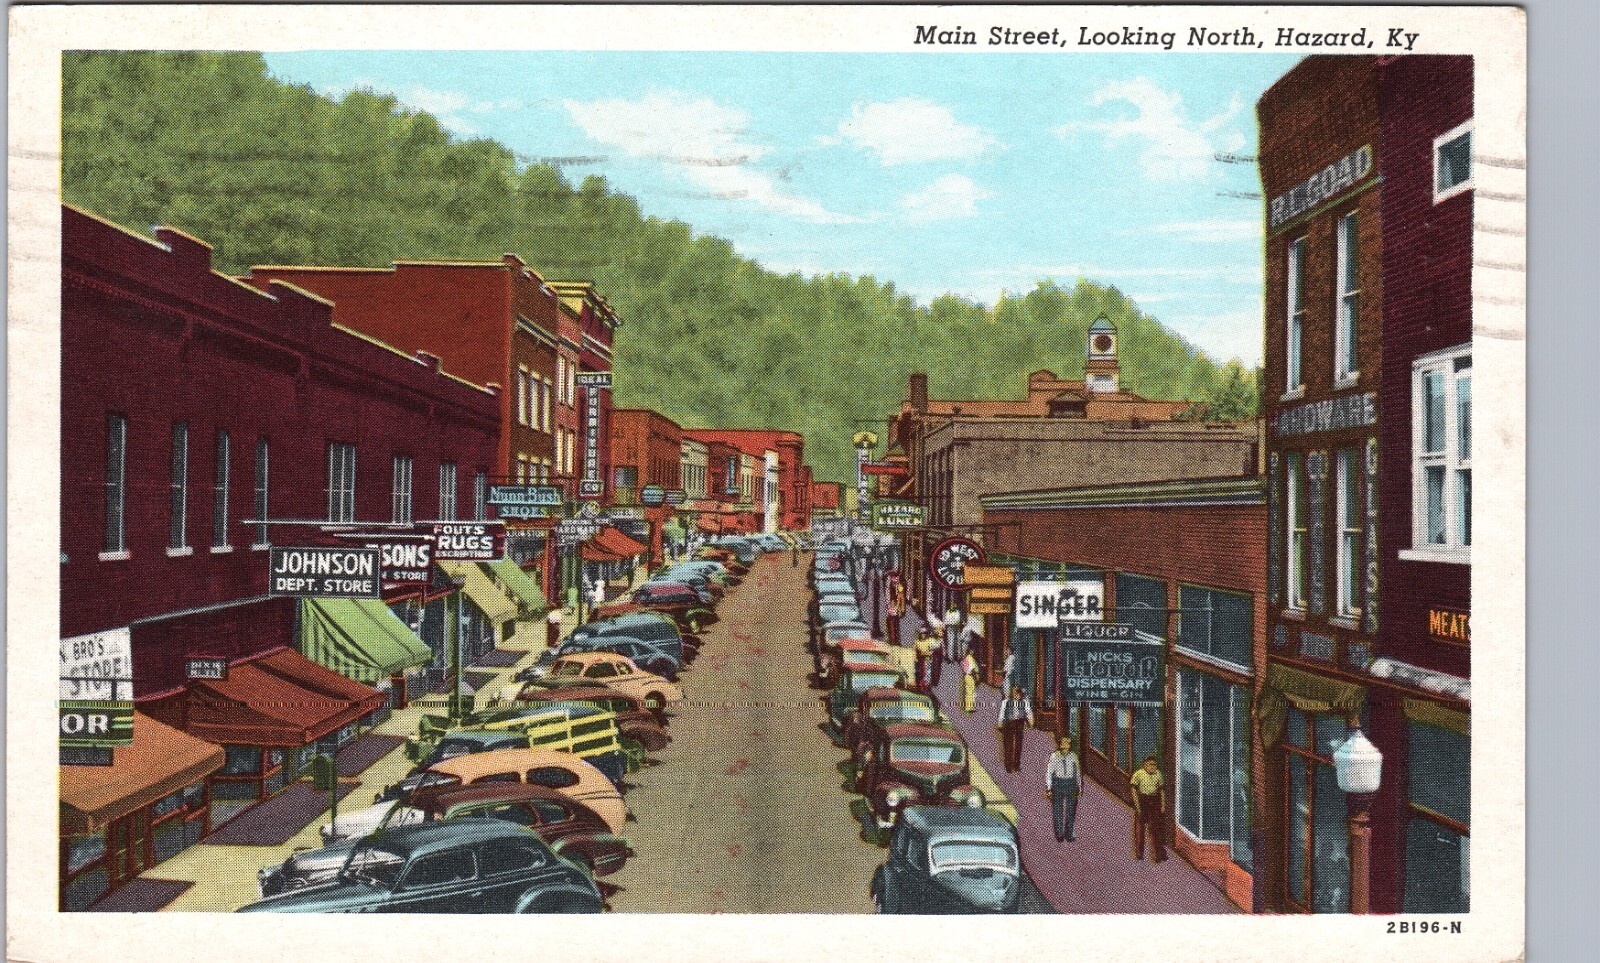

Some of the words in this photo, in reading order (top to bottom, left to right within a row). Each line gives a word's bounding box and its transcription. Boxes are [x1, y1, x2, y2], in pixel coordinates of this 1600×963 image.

[502, 506, 548, 517] SHOES
[878, 516, 922, 526] LUNCH
[433, 524, 485, 535] FOUTS
[275, 551, 374, 576] JOHNSON
[393, 571, 429, 581] STORE
[937, 565, 964, 586] LIQU
[276, 578, 317, 593] DEPT.
[323, 578, 374, 594] STORE
[1019, 595, 1101, 616] SINGER
[1065, 624, 1130, 639] LIQUOR
[1428, 609, 1471, 641] MEAT
[1087, 651, 1133, 663] NICKS
[69, 656, 122, 696] STORE
[1067, 678, 1153, 690] DISPENSARY
[1119, 690, 1144, 698] GIN
[61, 713, 110, 735] OR
